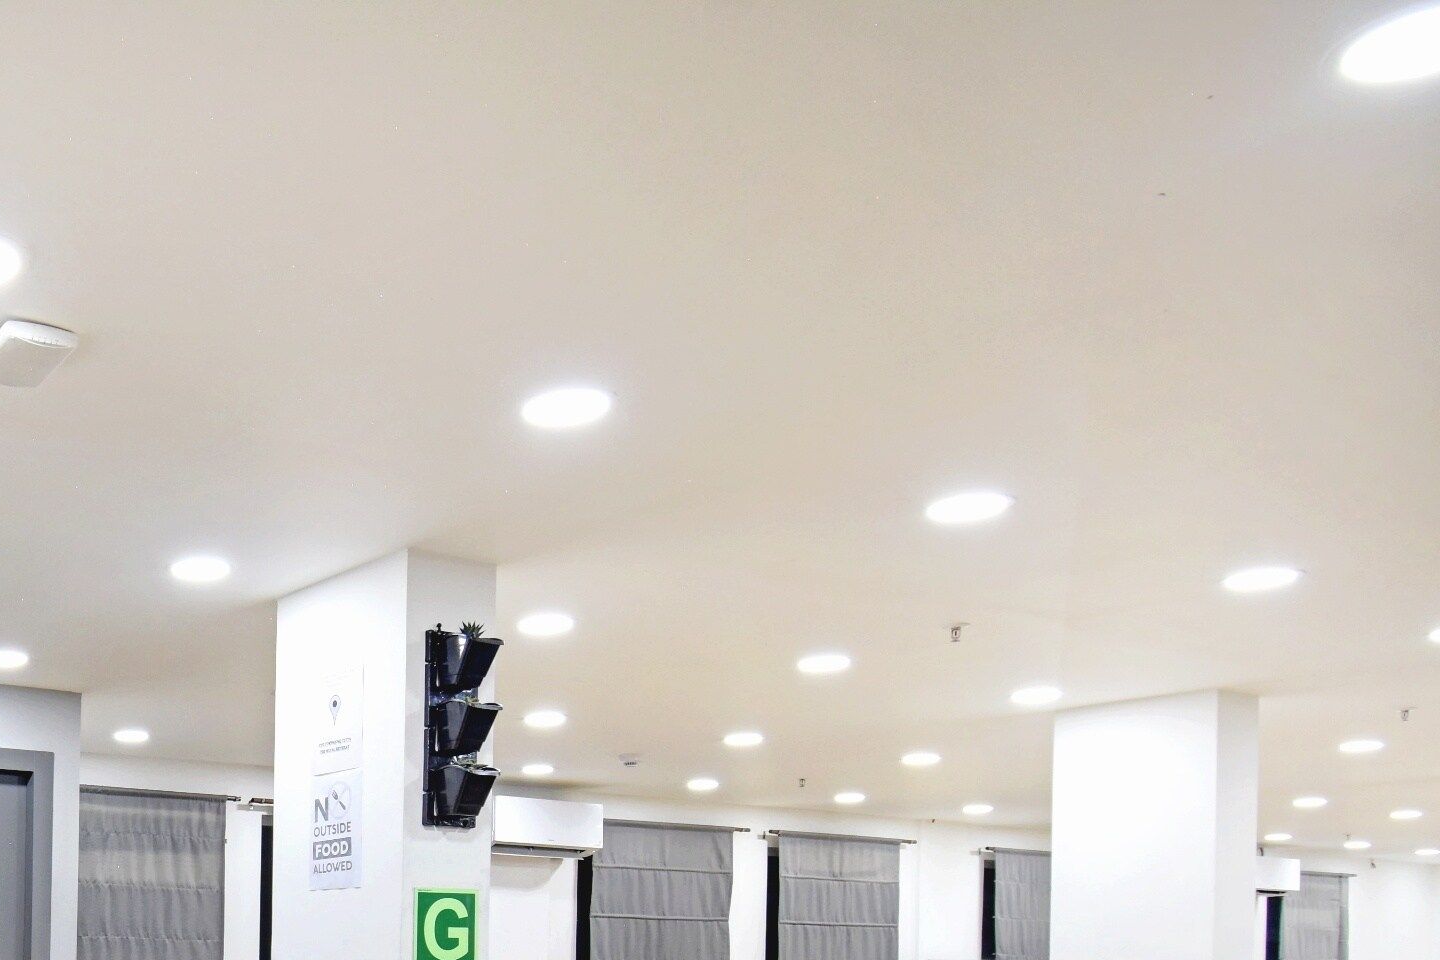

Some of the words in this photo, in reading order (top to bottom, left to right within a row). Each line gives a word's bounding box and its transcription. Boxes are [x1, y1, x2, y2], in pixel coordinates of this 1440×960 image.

[313, 821, 352, 838] OUTSIDE
[315, 840, 349, 859] FOOD
[313, 860, 353, 874] ALLOWED
[423, 897, 469, 960] G
